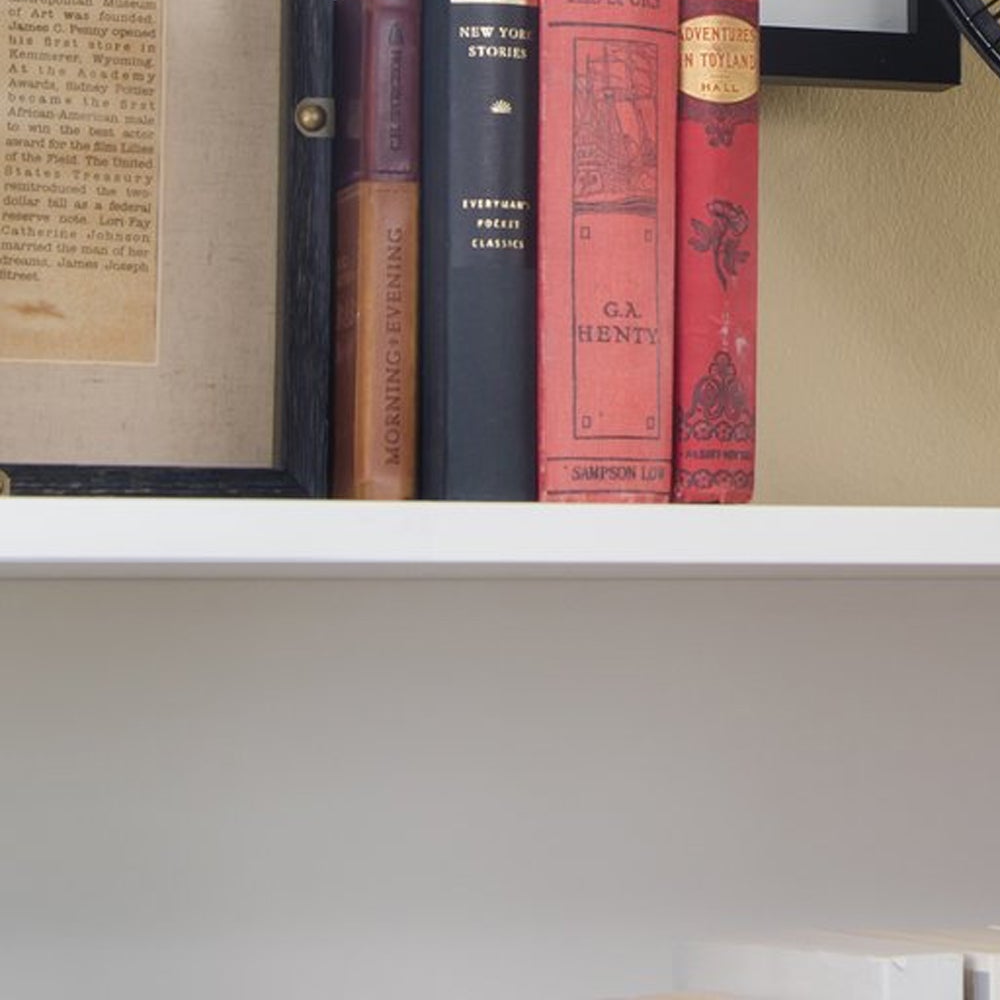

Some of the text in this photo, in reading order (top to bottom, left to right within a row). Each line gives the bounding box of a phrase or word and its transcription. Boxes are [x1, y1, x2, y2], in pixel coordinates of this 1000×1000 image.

[8, 7, 22, 17] of
[30, 8, 54, 18] Art
[64, 11, 89, 20] was
[8, 21, 49, 32] James
[53, 24, 65, 33] C.
[112, 27, 156, 39] opened
[459, 26, 495, 38] NEW
[9, 35, 33, 45] his
[88, 40, 131, 51] store
[140, 42, 156, 53] in
[468, 45, 528, 59] STORIES
[700, 52, 756, 70] TOYLAND
[8, 63, 156, 83] At the Academy
[66, 81, 109, 94] Sidney
[701, 83, 739, 93] HALL
[8, 92, 71, 104] became
[83, 97, 110, 107] the
[7, 122, 20, 131] to
[28, 124, 51, 134] win
[60, 125, 80, 135] the
[5, 137, 45, 148] award
[48, 139, 68, 149] for
[69, 140, 90, 150] the
[4, 152, 17, 162] of
[21, 153, 42, 163] the
[85, 155, 108, 167] The
[113, 157, 153, 169] United
[4, 165, 153, 186] States Treasury
[4, 182, 86, 194] reintroduced
[96, 186, 117, 196] the
[3, 195, 40, 207] dollar
[74, 200, 88, 210] as
[109, 201, 151, 213] federal
[2, 211, 50, 222] reserve
[477, 218, 520, 229] POCKET
[1, 225, 150, 243] Catherine Johnson
[1, 242, 150, 257] married the man of her
[471, 238, 525, 249] CLASSICS
[57, 257, 99, 269] James
[104, 260, 149, 273] Joseph
[577, 326, 658, 345] HENTY
[384, 227, 402, 466] MORNING EVENING
[571, 466, 636, 481] SAMPSON
